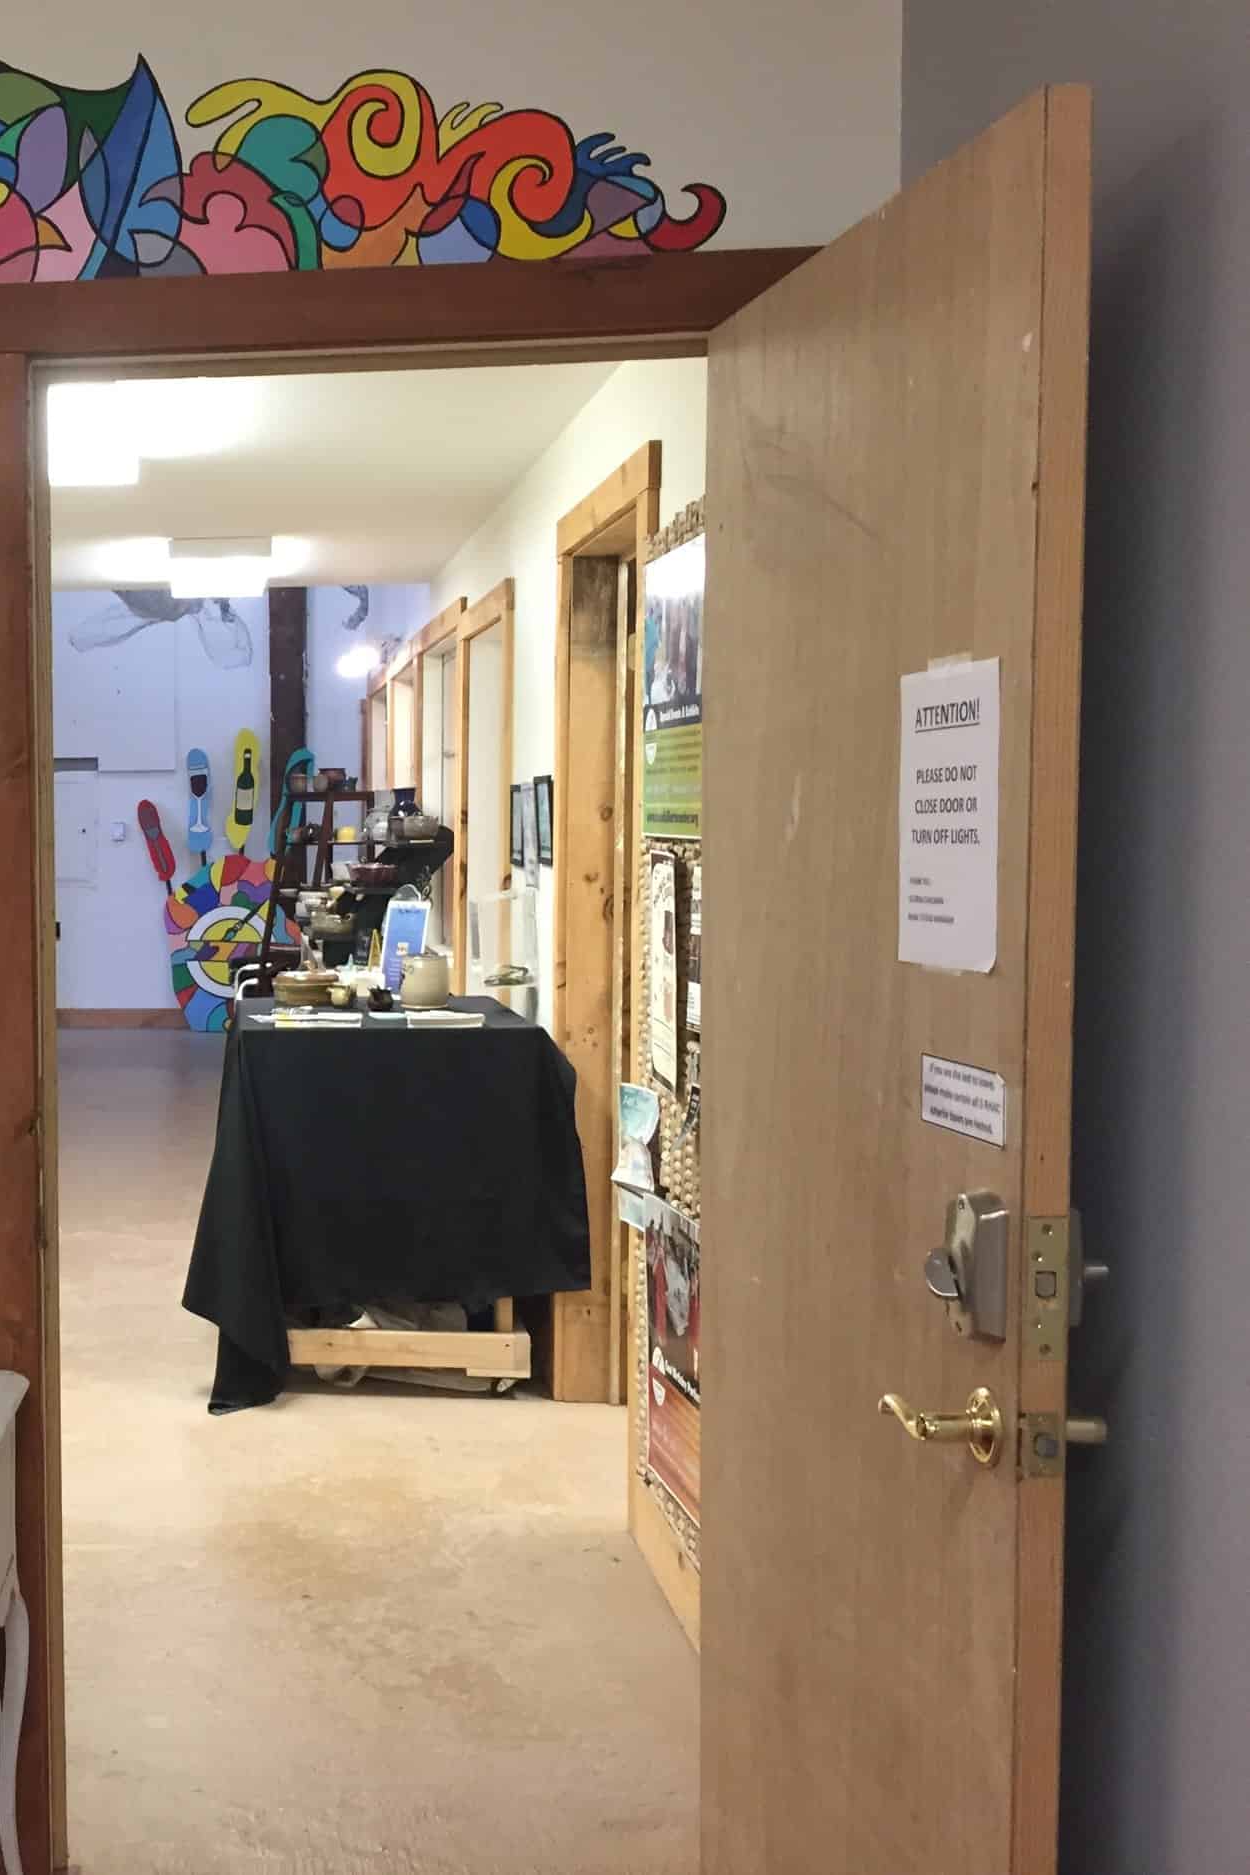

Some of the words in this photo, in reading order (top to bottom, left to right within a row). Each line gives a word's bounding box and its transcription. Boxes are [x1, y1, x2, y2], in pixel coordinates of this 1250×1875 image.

[915, 698, 980, 728] ATTENTION!
[916, 767, 943, 784] PLEASE
[945, 766, 958, 782] DO
[960, 765, 977, 781] NOT
[915, 799, 938, 814] CLOSE
[939, 798, 964, 813] DOOR
[912, 829, 931, 844] TURN
[933, 829, 950, 844] OFF
